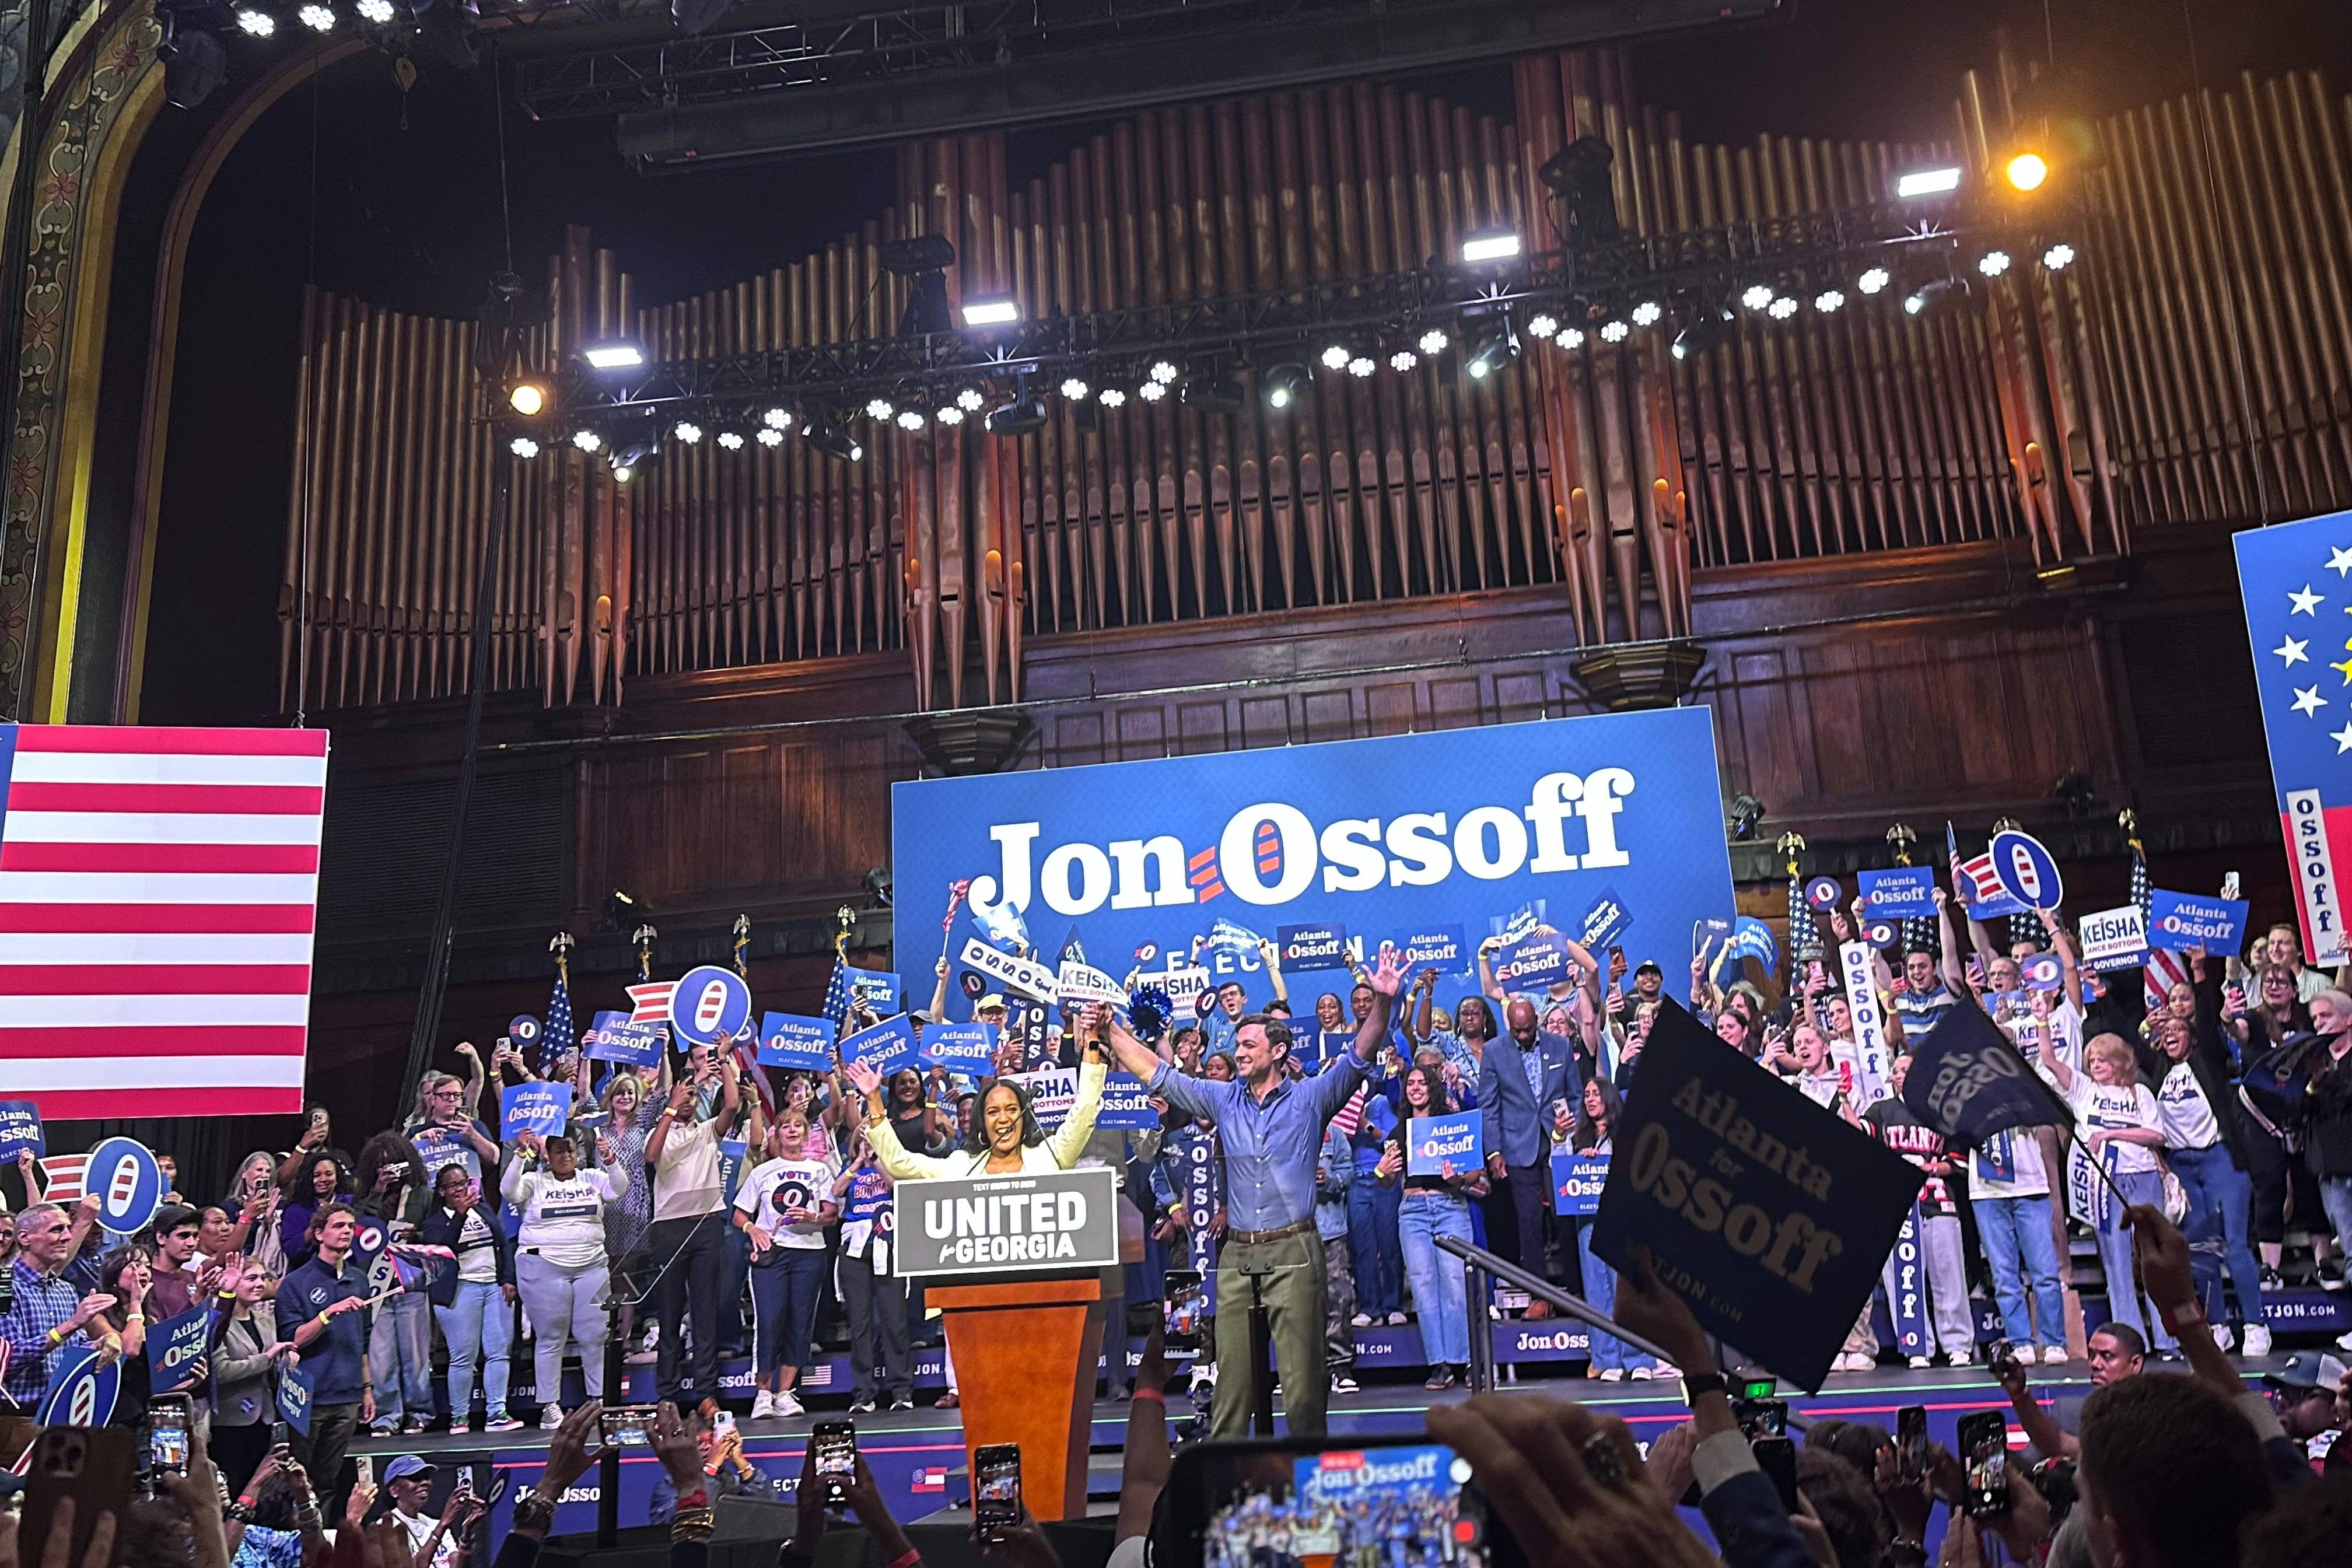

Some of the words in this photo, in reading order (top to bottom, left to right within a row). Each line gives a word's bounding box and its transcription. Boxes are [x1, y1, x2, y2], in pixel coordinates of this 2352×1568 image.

[968, 821, 1196, 918] Jon
[1219, 767, 1636, 906] Ossoff
[1875, 876, 1917, 887] Atlanta
[1870, 887, 1925, 905] Ossoff
[2174, 903, 2228, 919] Atlanta
[1293, 930, 1332, 942] Atlanta
[2083, 916, 2141, 945] KEISHA
[2163, 915, 2234, 939] Ossoff
[1409, 933, 1450, 945] Atlanta
[2108, 937, 2143, 951] BOTTOMS
[1288, 939, 1340, 959] Ossoff
[1406, 944, 1457, 963] Ossoff
[1514, 943, 1553, 958] Atlanta
[1510, 952, 1561, 977] Ossoff
[2093, 954, 2140, 970] GOVERNOR
[855, 975, 887, 987] Atlanta
[608, 1020, 650, 1033] Atlanta
[780, 1022, 822, 1035] Atlanta
[939, 1031, 983, 1040] Atlanta
[598, 1030, 655, 1051] Ossoff
[771, 1035, 827, 1054] Ossoff
[857, 1030, 897, 1052] Atlanta
[855, 1037, 908, 1069] Ossoff
[930, 1042, 989, 1059] Ossoff
[514, 1090, 552, 1103] Atlanta
[509, 1105, 559, 1122] Ossoff
[0, 1124, 40, 1143] ssoff
[1430, 1122, 1469, 1137] Atlanta
[1670, 1074, 1832, 1202] Atlanta
[418, 1142, 460, 1157] Atlanta
[1423, 1135, 1475, 1157] Ossoff
[425, 1151, 469, 1172] ssoff
[1572, 1163, 1609, 1175] Atlant
[1709, 1147, 1745, 1179] for
[777, 1170, 811, 1181] VOTE
[924, 1191, 1087, 1240] UNITED
[1629, 1120, 1843, 1296] Ossoff
[955, 1232, 1077, 1265] GEORGIA
[1517, 1332, 1550, 1351] Jon
[718, 1371, 757, 1388] ssoff
[1356, 1452, 1438, 1487] Ossoff
